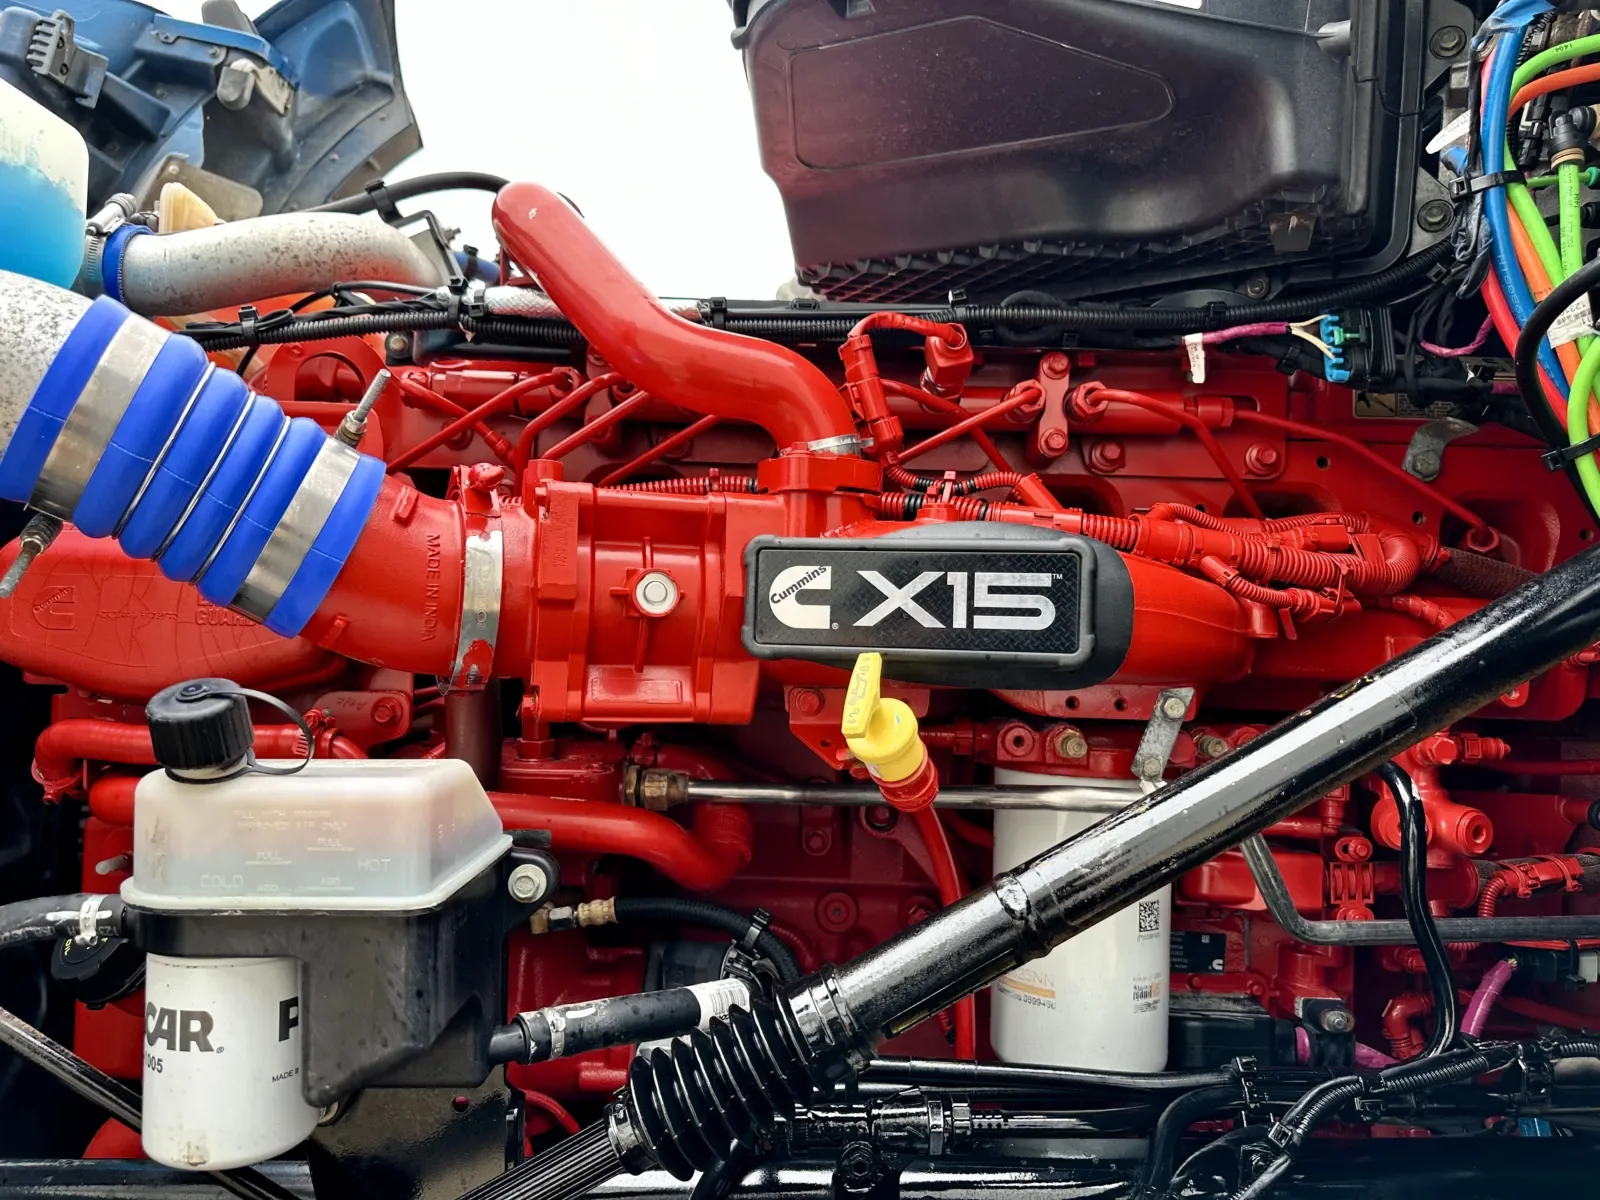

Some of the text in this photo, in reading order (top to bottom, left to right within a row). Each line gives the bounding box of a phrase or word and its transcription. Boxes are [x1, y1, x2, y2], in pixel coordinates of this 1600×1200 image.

[32, 586, 73, 614] Cummins
[421, 533, 441, 642] MADE IN INDIA
[770, 564, 828, 605] Cummins
[853, 570, 1056, 630] X15
[200, 873, 244, 889] COLD
[357, 858, 391, 873] HOT
[146, 1001, 215, 1053] CAR
[271, 1069, 294, 1083] MADE
